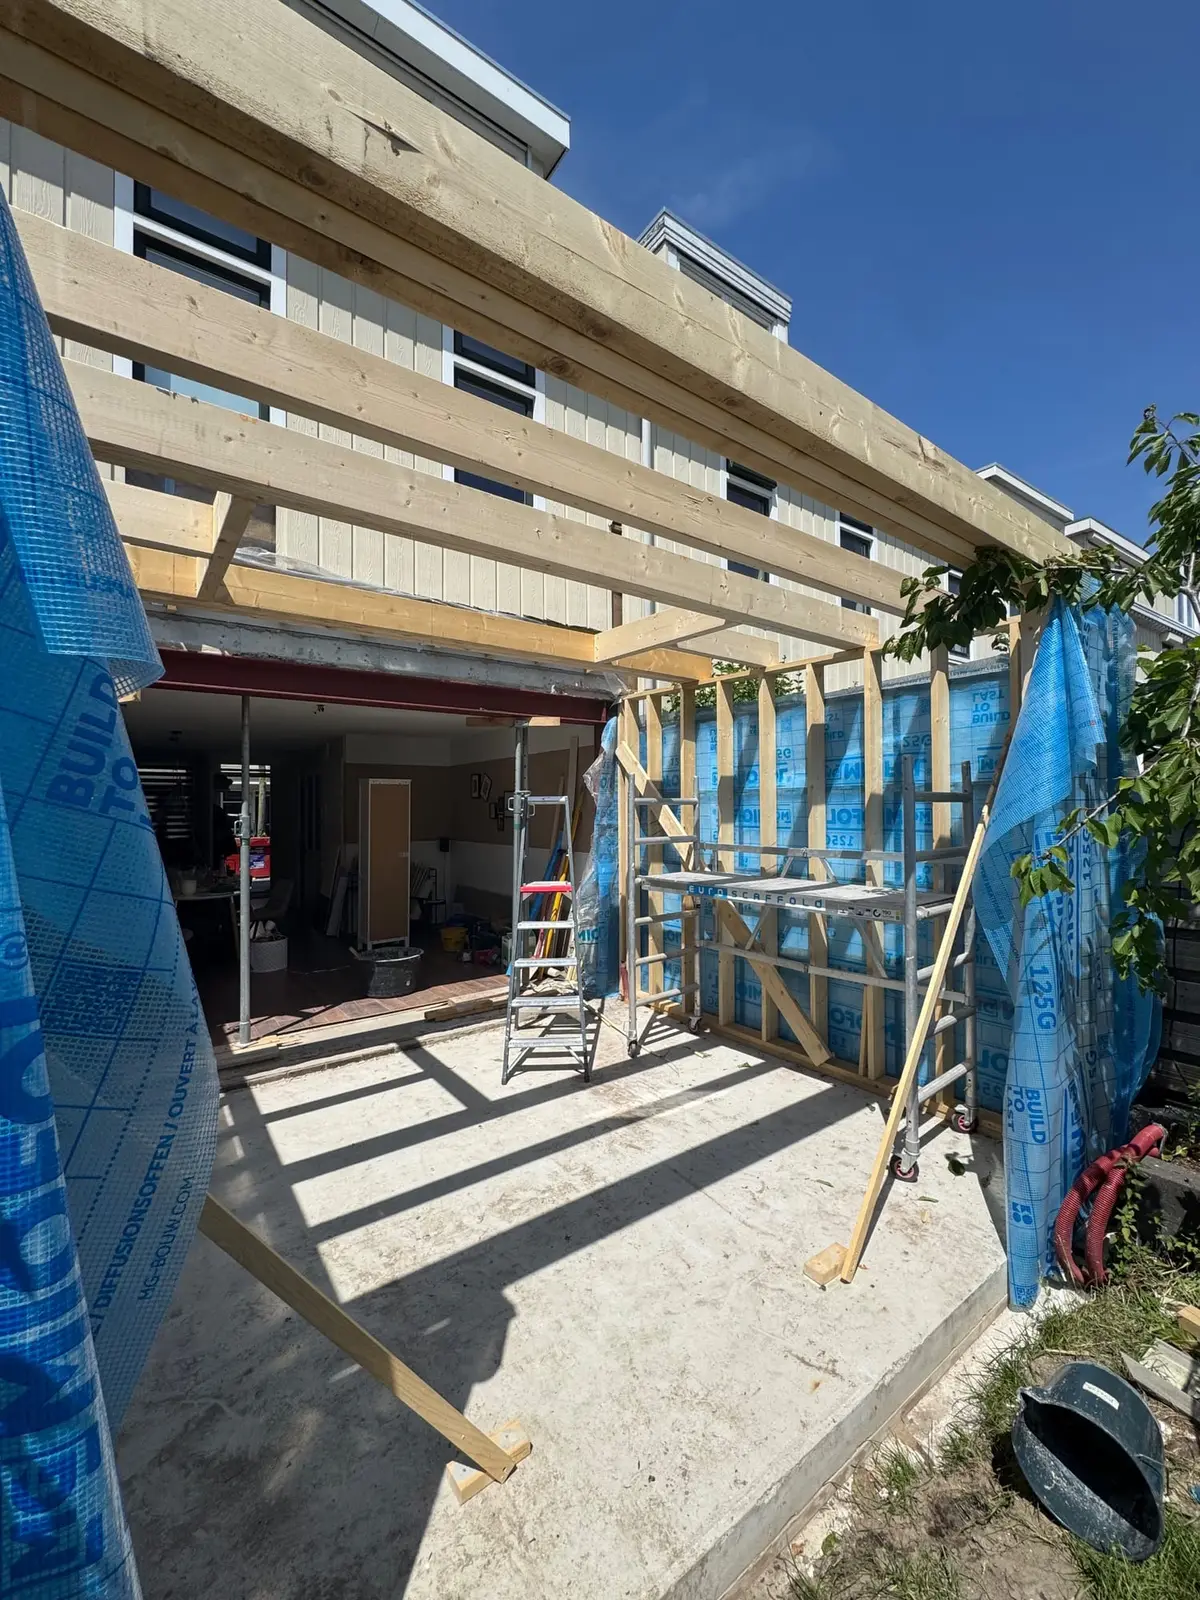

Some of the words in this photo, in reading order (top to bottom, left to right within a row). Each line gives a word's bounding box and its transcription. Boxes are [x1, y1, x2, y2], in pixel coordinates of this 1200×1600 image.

[47, 673, 118, 808] BUILD
[98, 756, 138, 821] TO
[1028, 964, 1057, 1031] 125G
[1013, 1089, 1026, 1113] TO
[1025, 1088, 1047, 1145] BUILD
[94, 1134, 175, 1310] DIFFUSIONSOFFEN
[168, 1039, 198, 1119] OUVERT
[138, 1175, 195, 1302] MG-BOUW.COM
